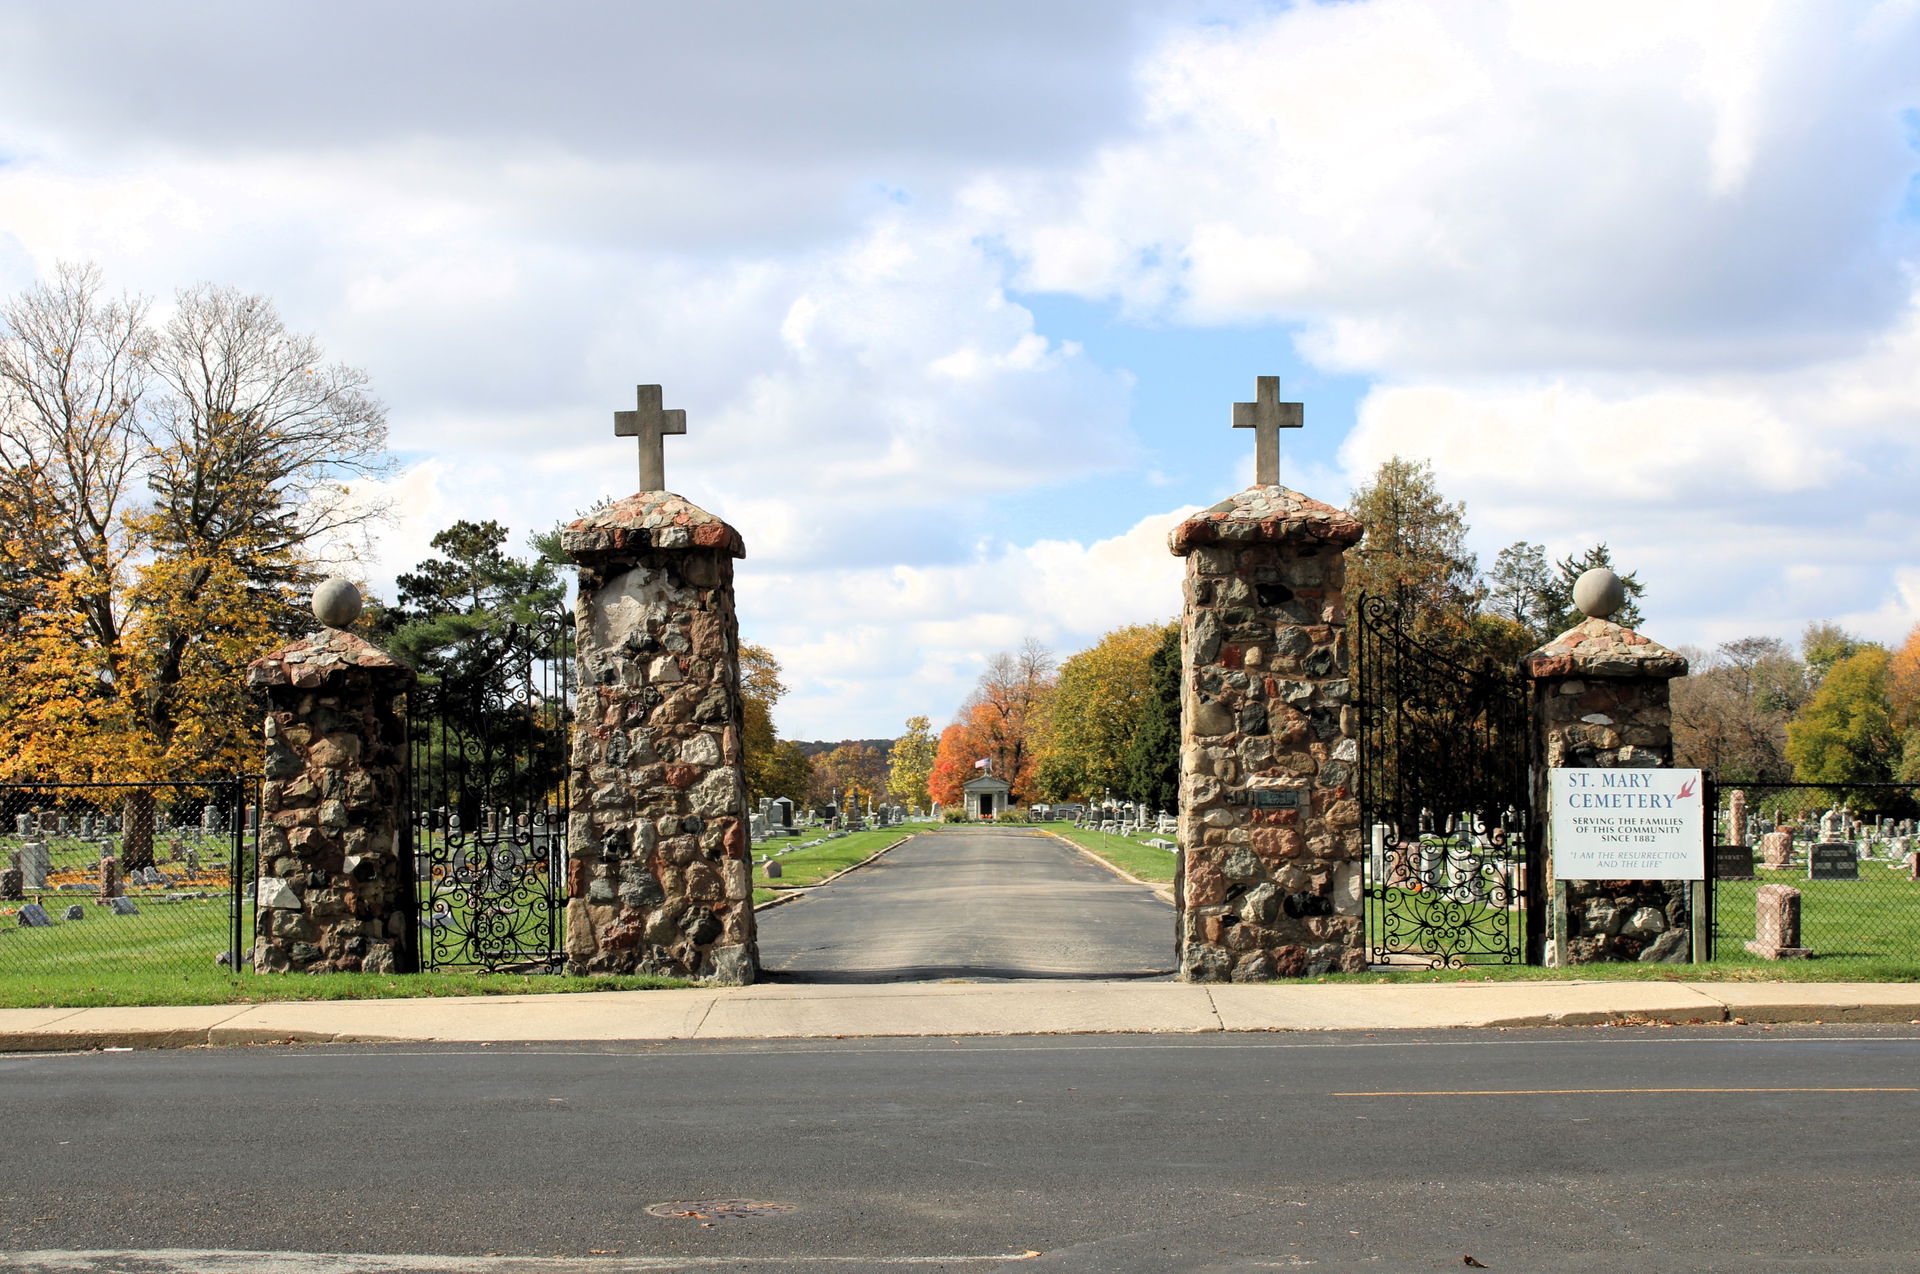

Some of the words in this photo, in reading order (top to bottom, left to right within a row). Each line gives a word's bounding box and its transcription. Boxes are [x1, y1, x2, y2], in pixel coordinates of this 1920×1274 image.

[1569, 773, 1595, 788] ST.
[1602, 773, 1653, 788] MARY
[1568, 793, 1677, 809] CEMETERY
[1572, 817, 1615, 825] SERVING
[1618, 817, 1638, 825] THE
[1575, 826, 1591, 834] OF
[1593, 826, 1615, 834] THIS
[1617, 826, 1681, 834] COMMUNITY
[1634, 835, 1656, 843] 1882
[1579, 851, 1595, 859] AM
[1598, 851, 1615, 859] THE
[1618, 851, 1688, 860] RESURRECTION
[1596, 860, 1618, 868] AND
[1621, 860, 1638, 868] THE
